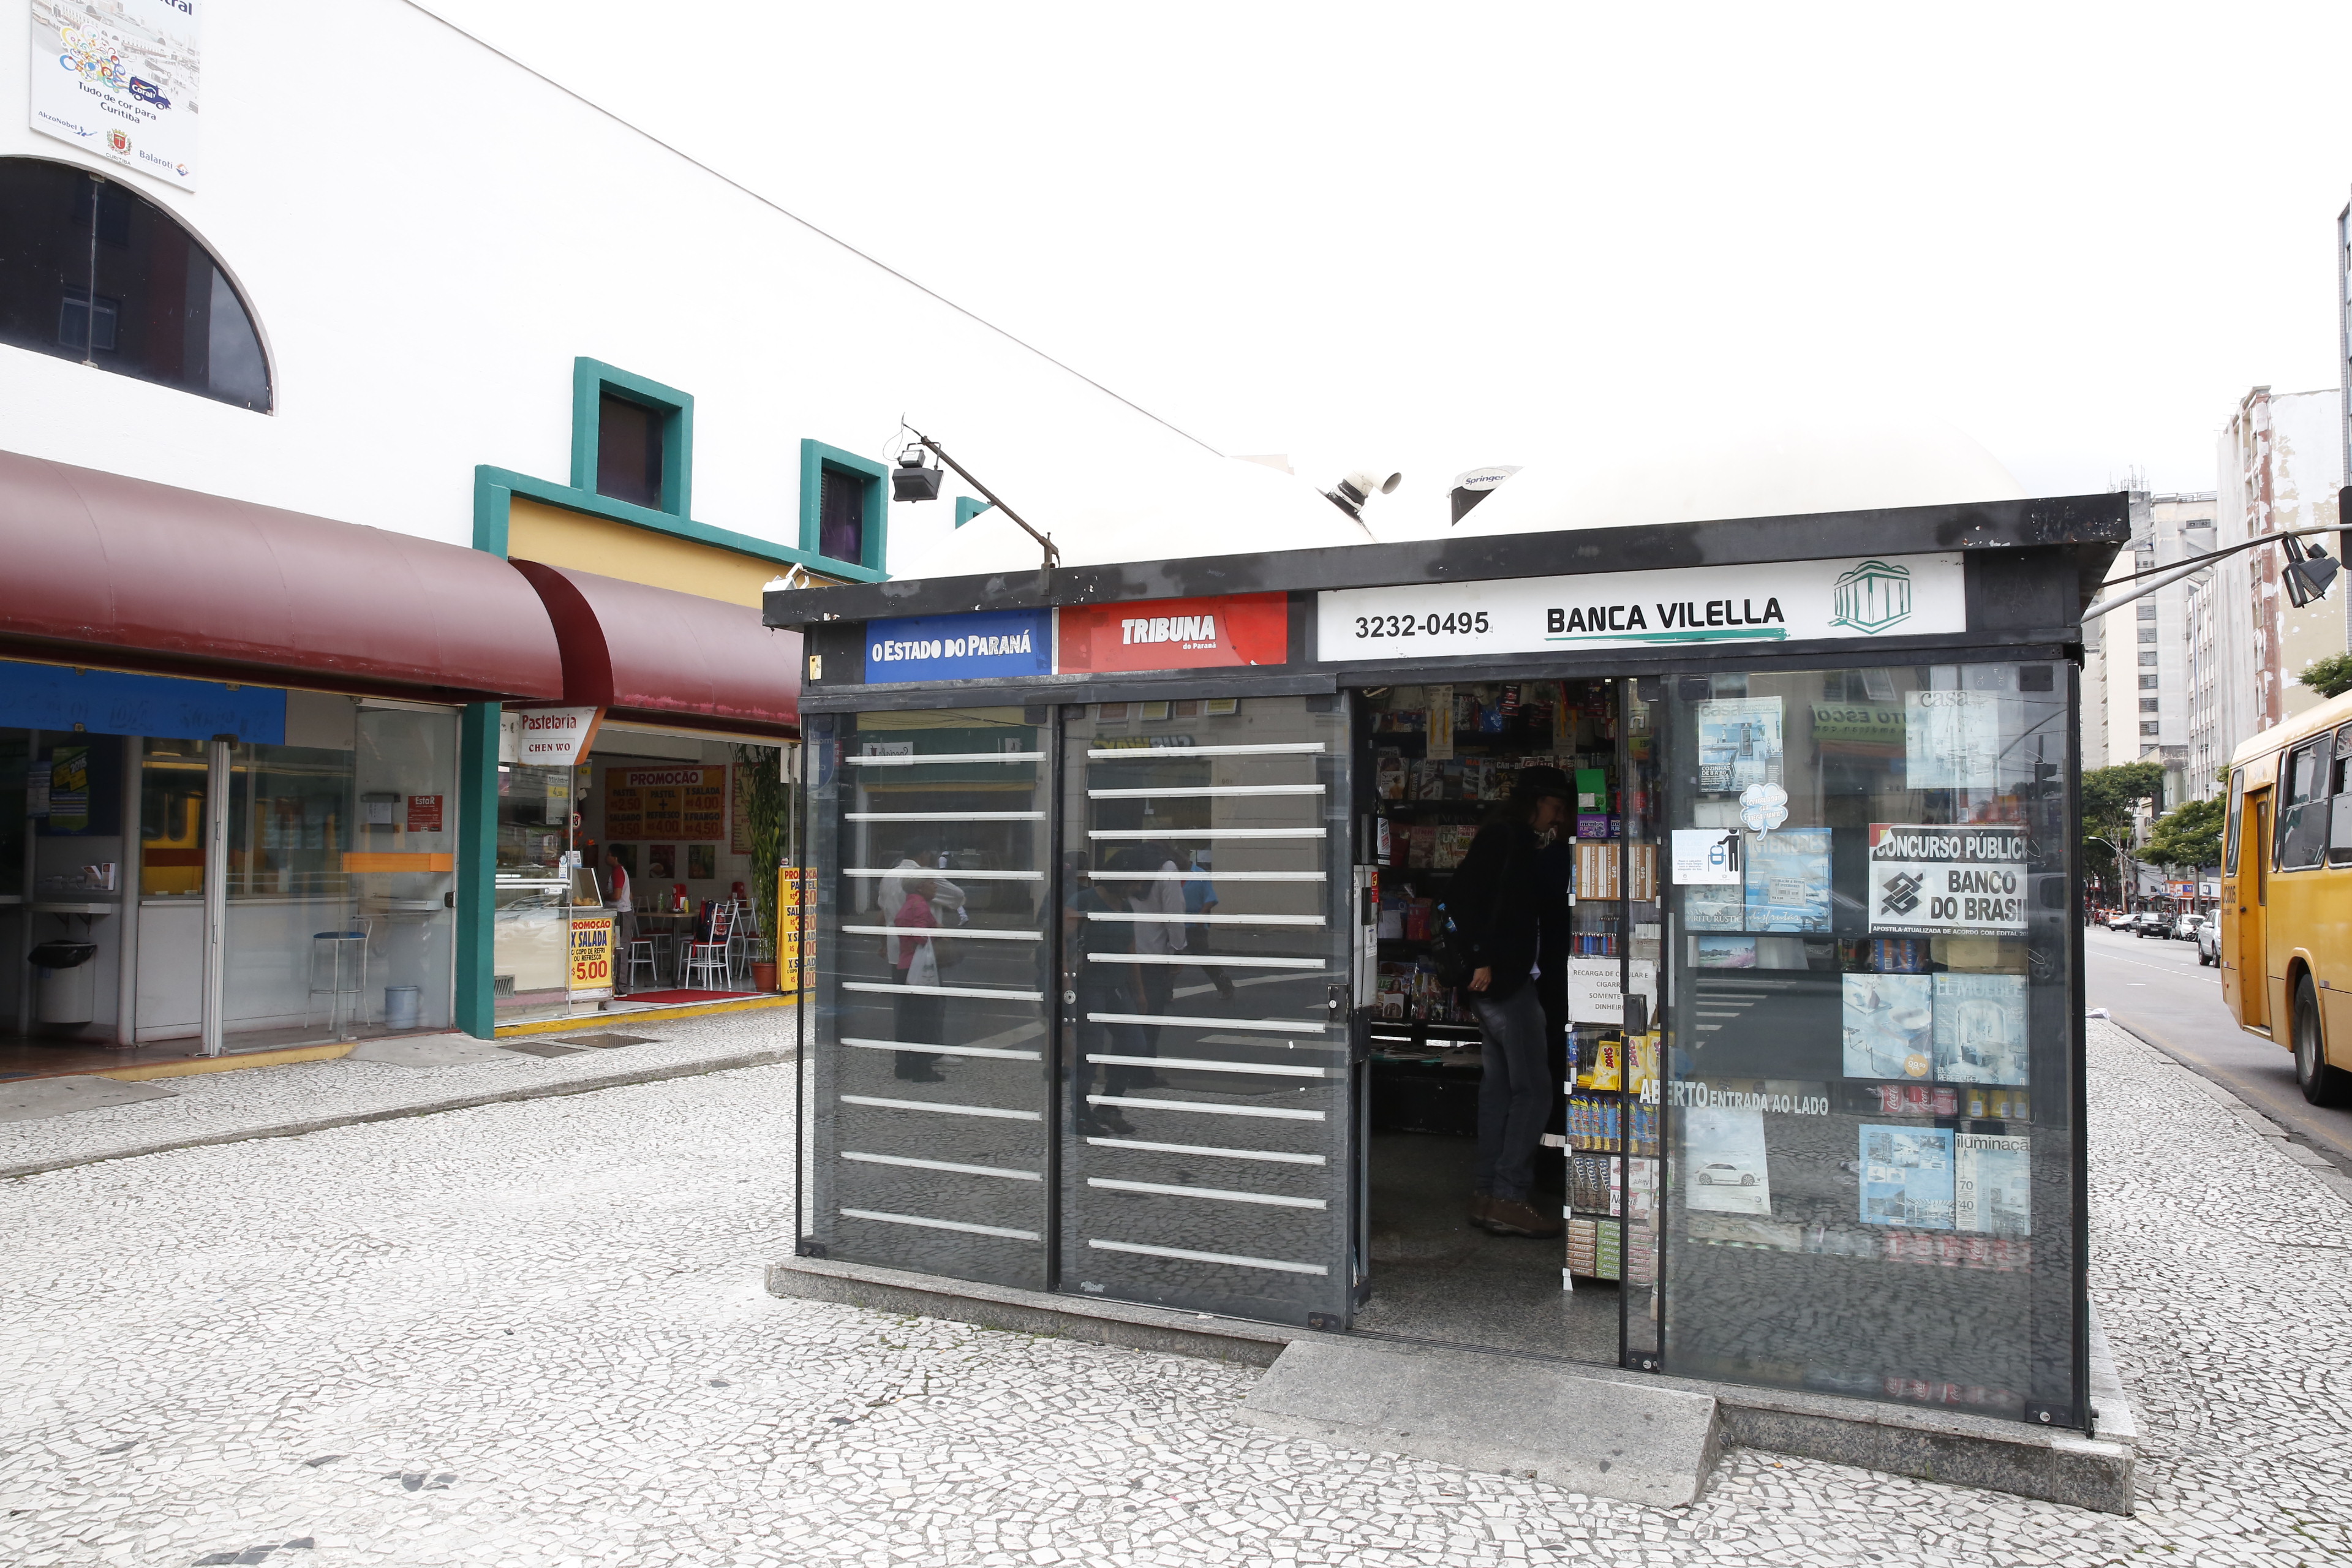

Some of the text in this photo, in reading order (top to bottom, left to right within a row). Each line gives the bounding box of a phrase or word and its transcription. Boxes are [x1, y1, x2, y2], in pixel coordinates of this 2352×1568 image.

[131, 83, 155, 99] Coral
[78, 81, 157, 121] Tudo de cor para
[38, 110, 77, 130] AkzoNobel
[100, 102, 140, 124] Curitiba
[105, 152, 131, 166] CURITIBA
[139, 149, 173, 170] Balaroti
[1465, 474, 1506, 485] Springer
[1547, 597, 1785, 633] BANCA VILELLA
[1121, 615, 1216, 644] TRIBUNA
[1355, 611, 1489, 638] 3232-0495
[872, 629, 1031, 662] O ESTADO DO PARANÁ
[1920, 690, 1970, 707] casa
[1701, 704, 1740, 717] casa
[522, 714, 576, 729] Pastelaria
[70, 757, 88, 774] 2015
[630, 771, 699, 785] PROMOÇÃO
[618, 797, 641, 811] 2,50
[695, 796, 718, 810] 4,00
[1746, 796, 1767, 805] COMPRE
[647, 811, 680, 820] REFRESCO
[1747, 810, 1783, 822] MEGA MANIA!
[695, 822, 718, 835] 4,50
[791, 881, 816, 890] PATEL
[1948, 870, 2016, 894] BANCO
[1931, 896, 1958, 920] DO
[1714, 914, 1742, 922] RÚSTIC
[1749, 910, 1800, 924] disfrutar
[578, 930, 607, 948] SALADA
[577, 960, 608, 981] 5,00
[1937, 976, 1953, 996] EL
[1604, 1047, 1614, 1069] SHOT
[1629, 1039, 1639, 1068] SHOT
[1709, 1090, 1769, 1112] ENTRADA
[1772, 1094, 1790, 1114] AO
[1794, 1096, 1829, 1116] LADO
[1957, 1135, 2030, 1154] iluminaçã
[1959, 1180, 1973, 1190] 70
